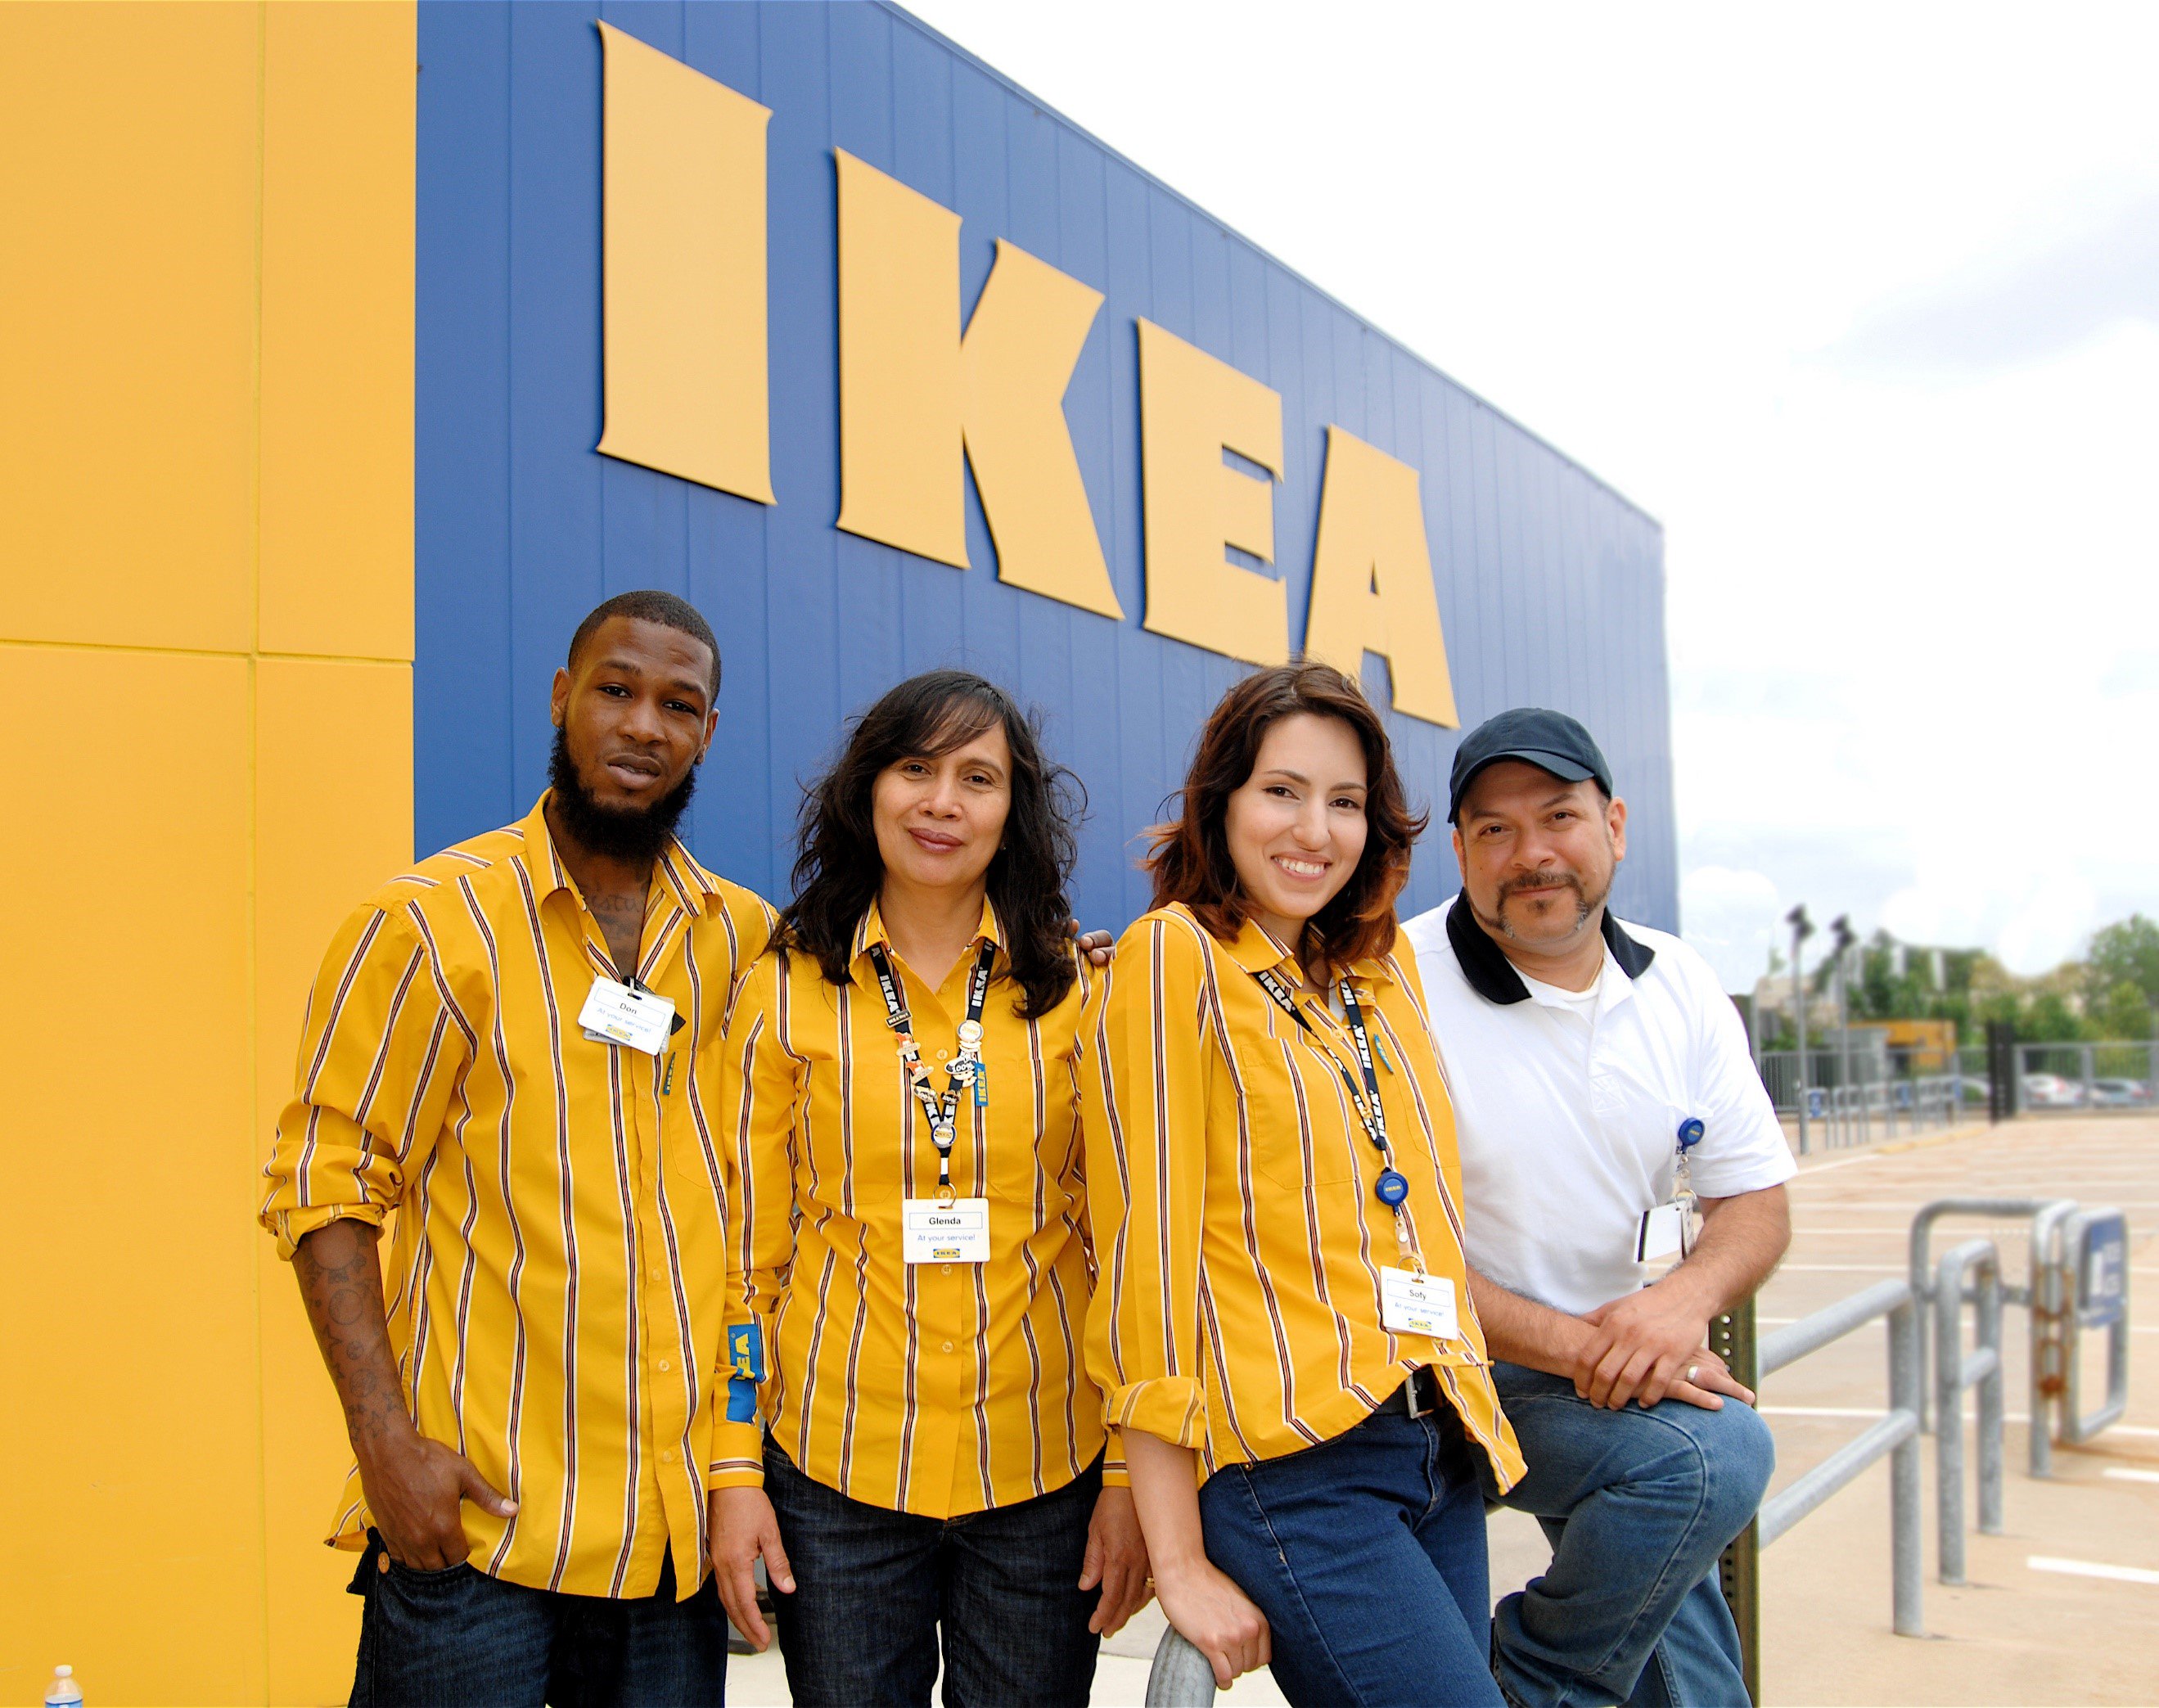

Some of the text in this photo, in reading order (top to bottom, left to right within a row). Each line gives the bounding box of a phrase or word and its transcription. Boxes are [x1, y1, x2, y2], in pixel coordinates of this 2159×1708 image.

[596, 18, 1460, 730] IKEA
[879, 974, 899, 1014] IKEA
[971, 969, 989, 1007] IKEA
[1258, 971, 1293, 1013] IKEA
[607, 1013, 623, 1021] your
[620, 1003, 638, 1015] Don
[1354, 1026, 1372, 1069] IKEA
[977, 1070, 987, 1102] IKEA
[929, 1217, 961, 1225] Glenda
